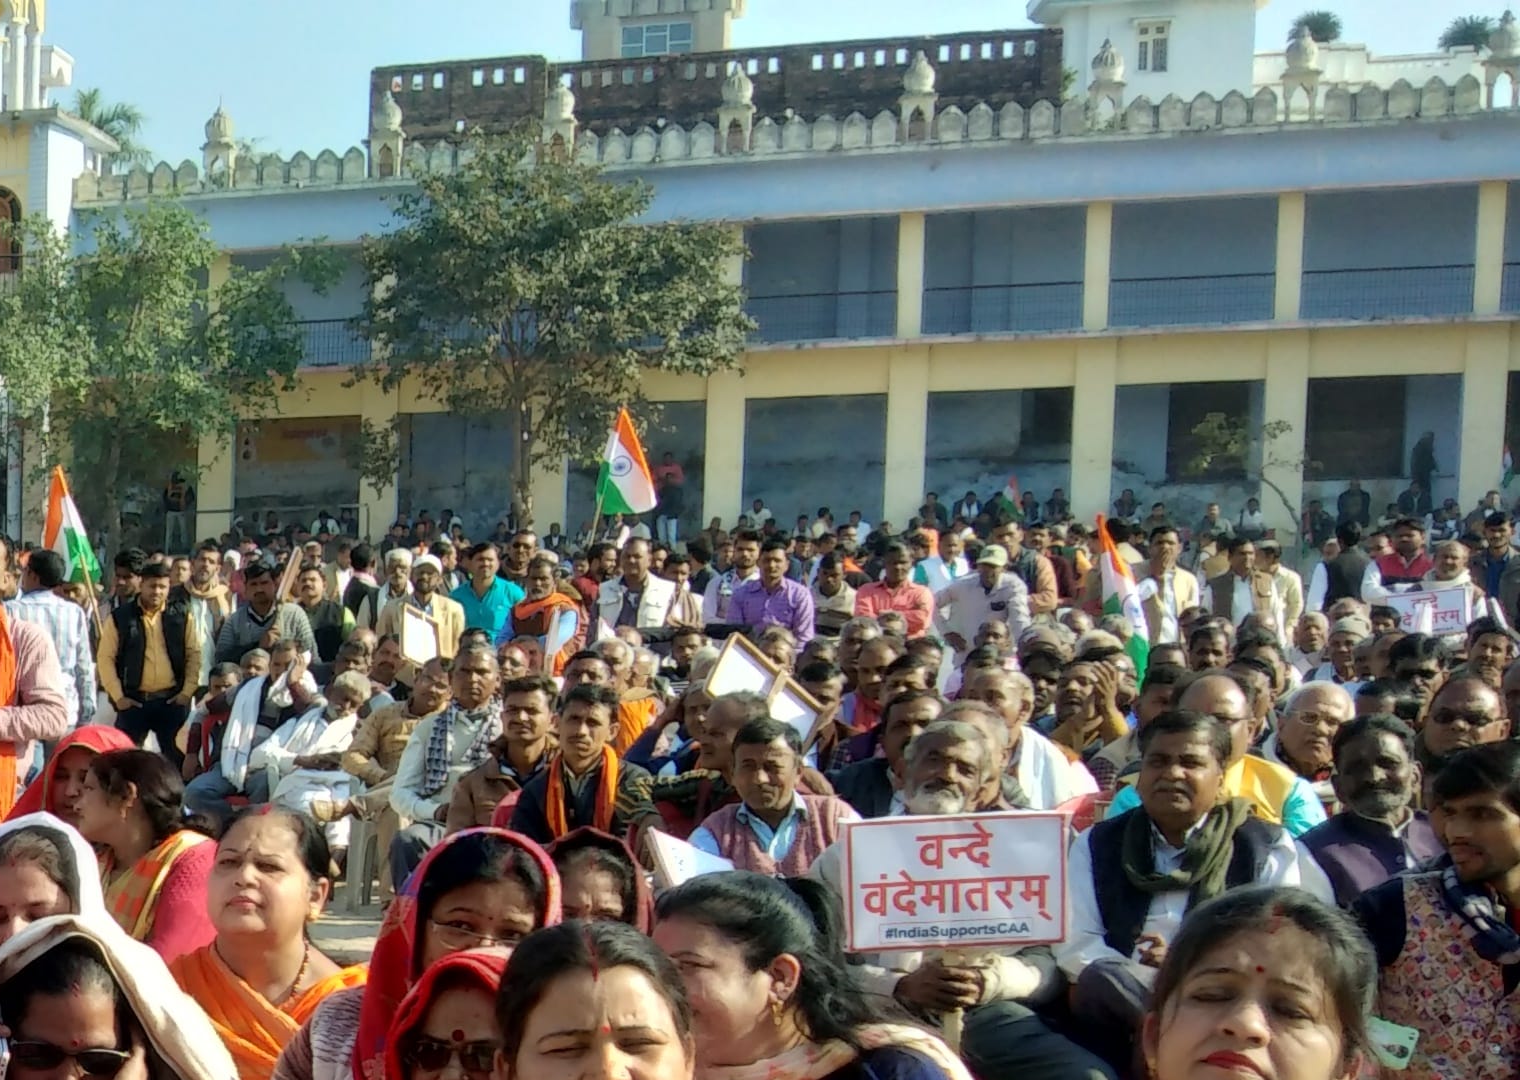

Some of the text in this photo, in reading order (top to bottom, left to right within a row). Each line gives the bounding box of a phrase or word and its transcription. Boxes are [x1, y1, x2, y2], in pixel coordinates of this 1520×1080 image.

[916, 822, 993, 869] वन्दे
[861, 870, 1052, 920] वंदेमातरम्
[885, 922, 1030, 939] #IndiaSupportsCAA
